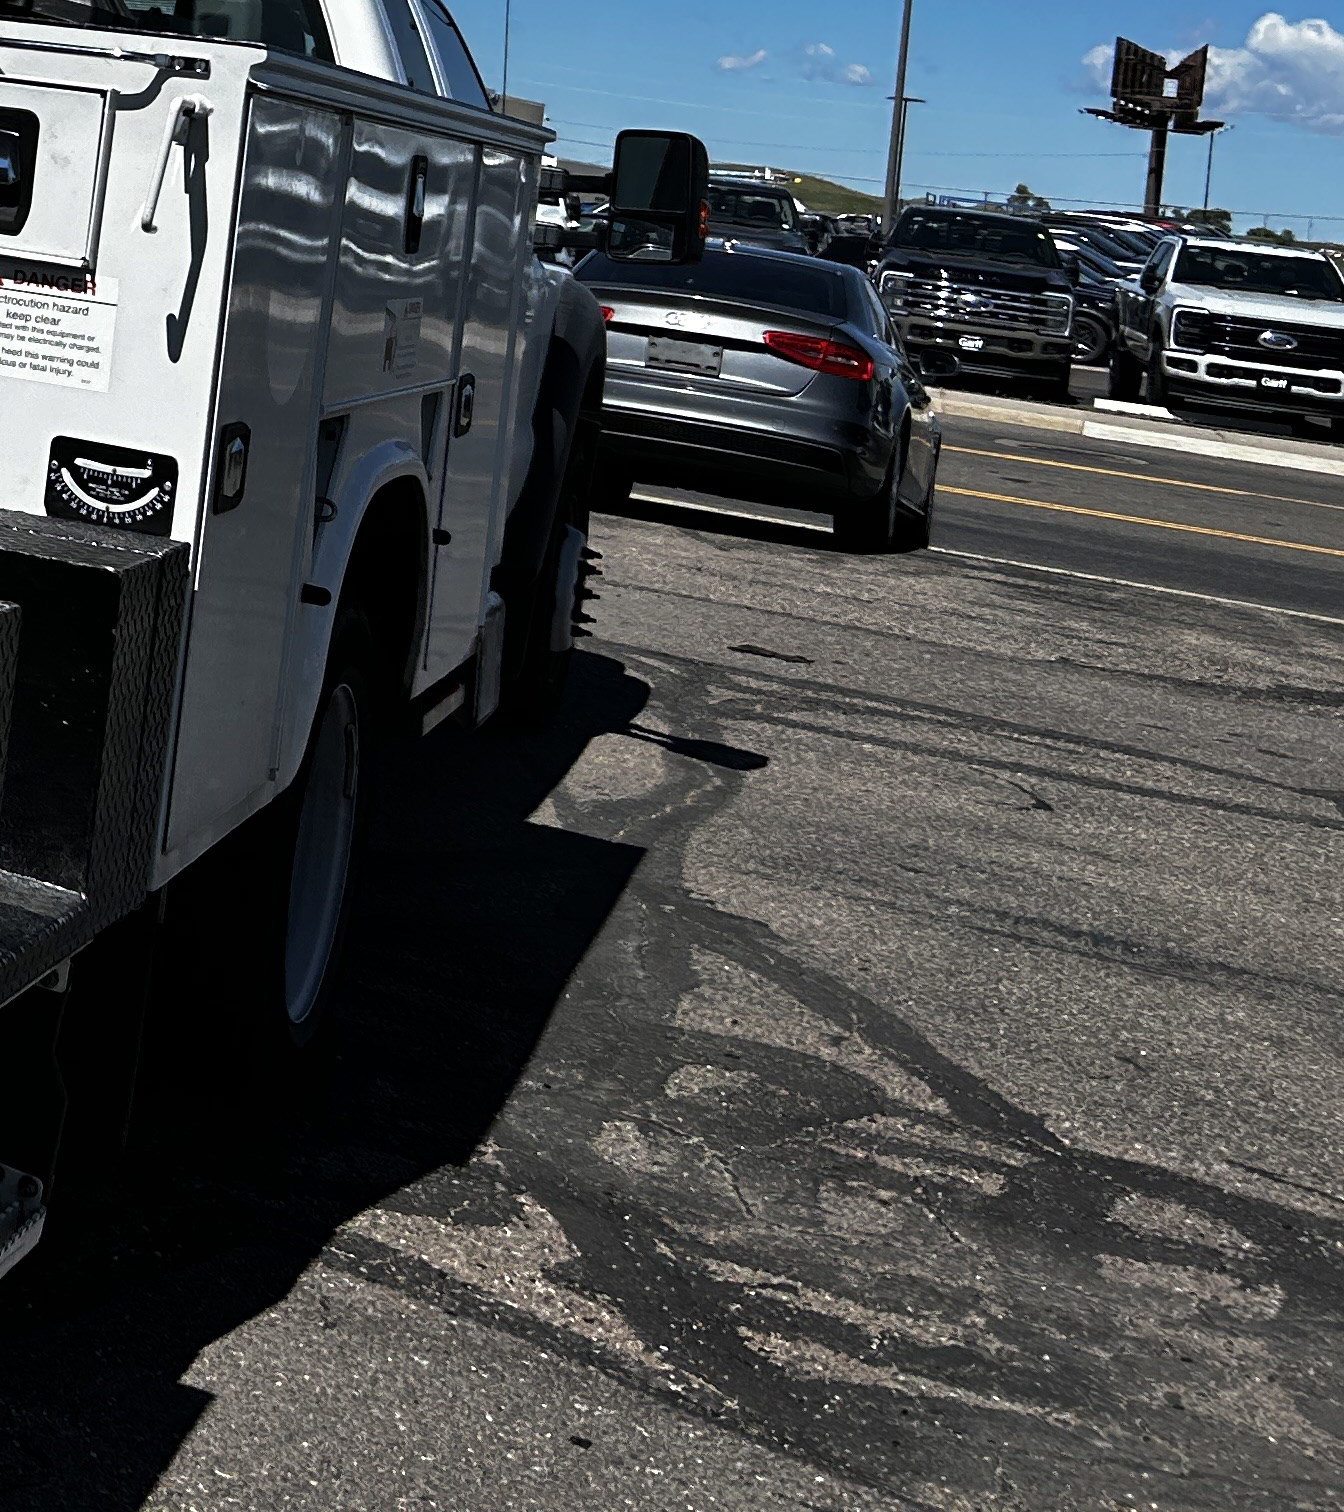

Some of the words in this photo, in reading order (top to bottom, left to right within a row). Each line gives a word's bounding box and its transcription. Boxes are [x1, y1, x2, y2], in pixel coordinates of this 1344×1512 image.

[13, 269, 97, 296] DANGER
[51, 301, 90, 316] hazard
[5, 308, 32, 323] keep
[34, 314, 61, 326] clear
[27, 335, 67, 349] electrically
[46, 329, 86, 341] equipment
[1, 346, 23, 357] heed
[24, 350, 39, 360] this
[41, 354, 75, 367] warning
[76, 359, 100, 370] could
[18, 361, 28, 369] or
[29, 361, 47, 372] fatal
